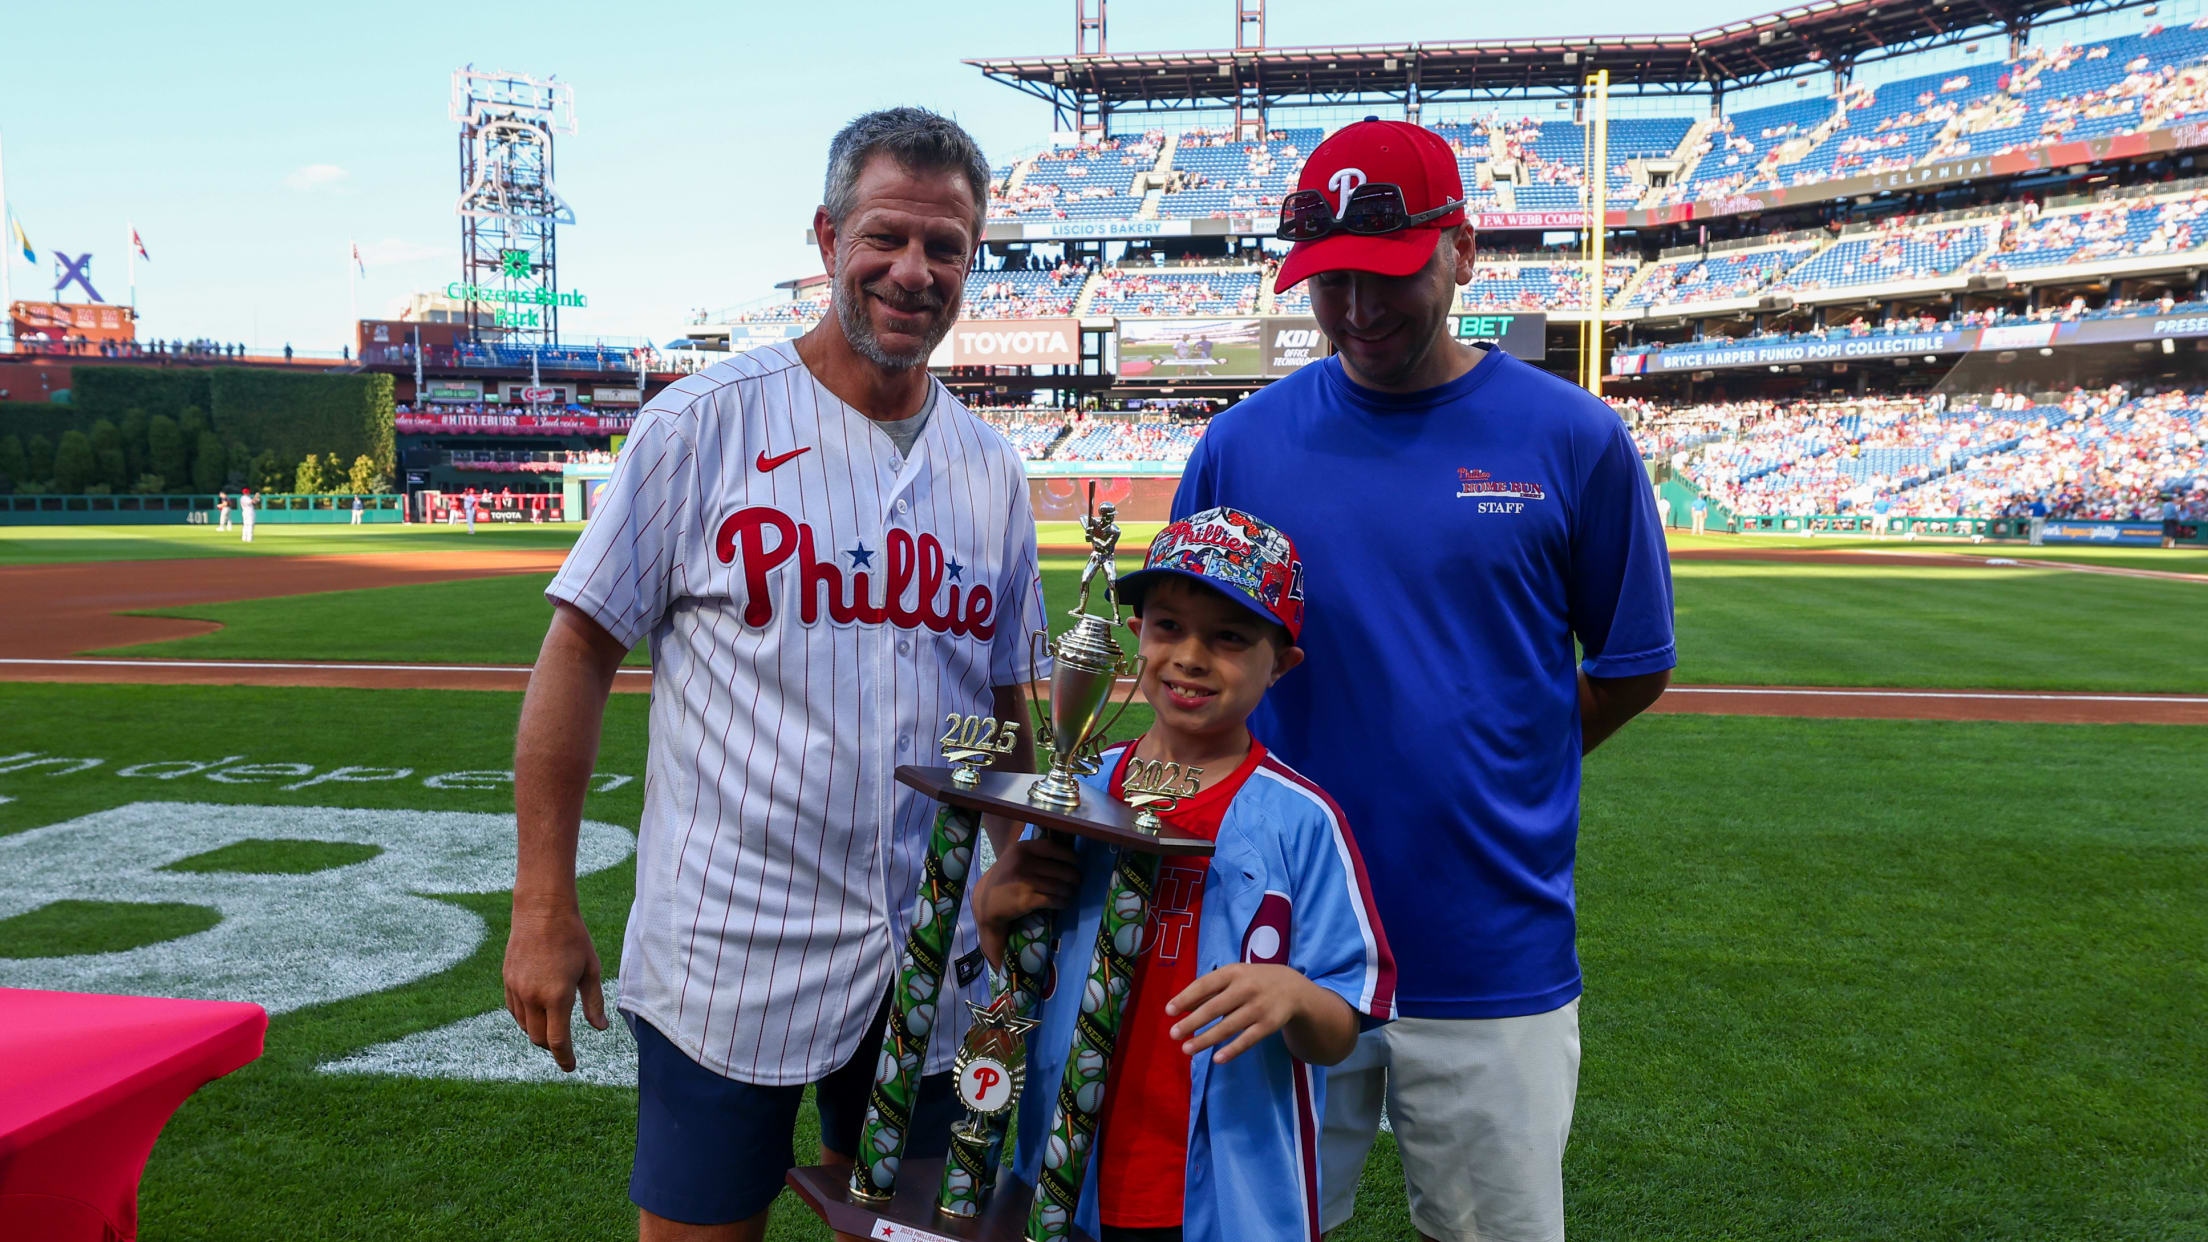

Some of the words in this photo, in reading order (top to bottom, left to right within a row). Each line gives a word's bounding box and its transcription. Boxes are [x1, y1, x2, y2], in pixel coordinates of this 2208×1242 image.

[1507, 214, 1543, 225] WEBB
[1544, 213, 1594, 225] COMPAN
[1052, 224, 1106, 236] LISCIO'S
[1110, 223, 1162, 234] BAKERY
[447, 281, 533, 304] Citizens
[535, 287, 585, 308] Bank
[494, 307, 539, 327] Park
[958, 331, 1070, 355] TOYOTA
[1274, 329, 1321, 348] KDI
[1284, 348, 1310, 358] OFFICE
[1663, 354, 1703, 368] BRYCE
[1706, 351, 1756, 366] HARPER
[1759, 347, 1804, 362] FUNKO
[1808, 344, 1841, 358] POP!
[1845, 336, 1944, 355] COLLECTIBLE
[1272, 356, 1321, 368] TECHNOLO
[1457, 467, 1492, 481] Phillies
[1463, 482, 1507, 493] HOME
[1510, 481, 1542, 495] RUN
[490, 511, 522, 520] TOYOTA
[1478, 502, 1524, 514] STAFF
[186, 511, 208, 524] 401
[1168, 522, 1251, 557] Phillies
[940, 713, 1020, 752] 2025
[1121, 756, 1204, 797] 2025
[973, 1067, 1000, 1101] P
